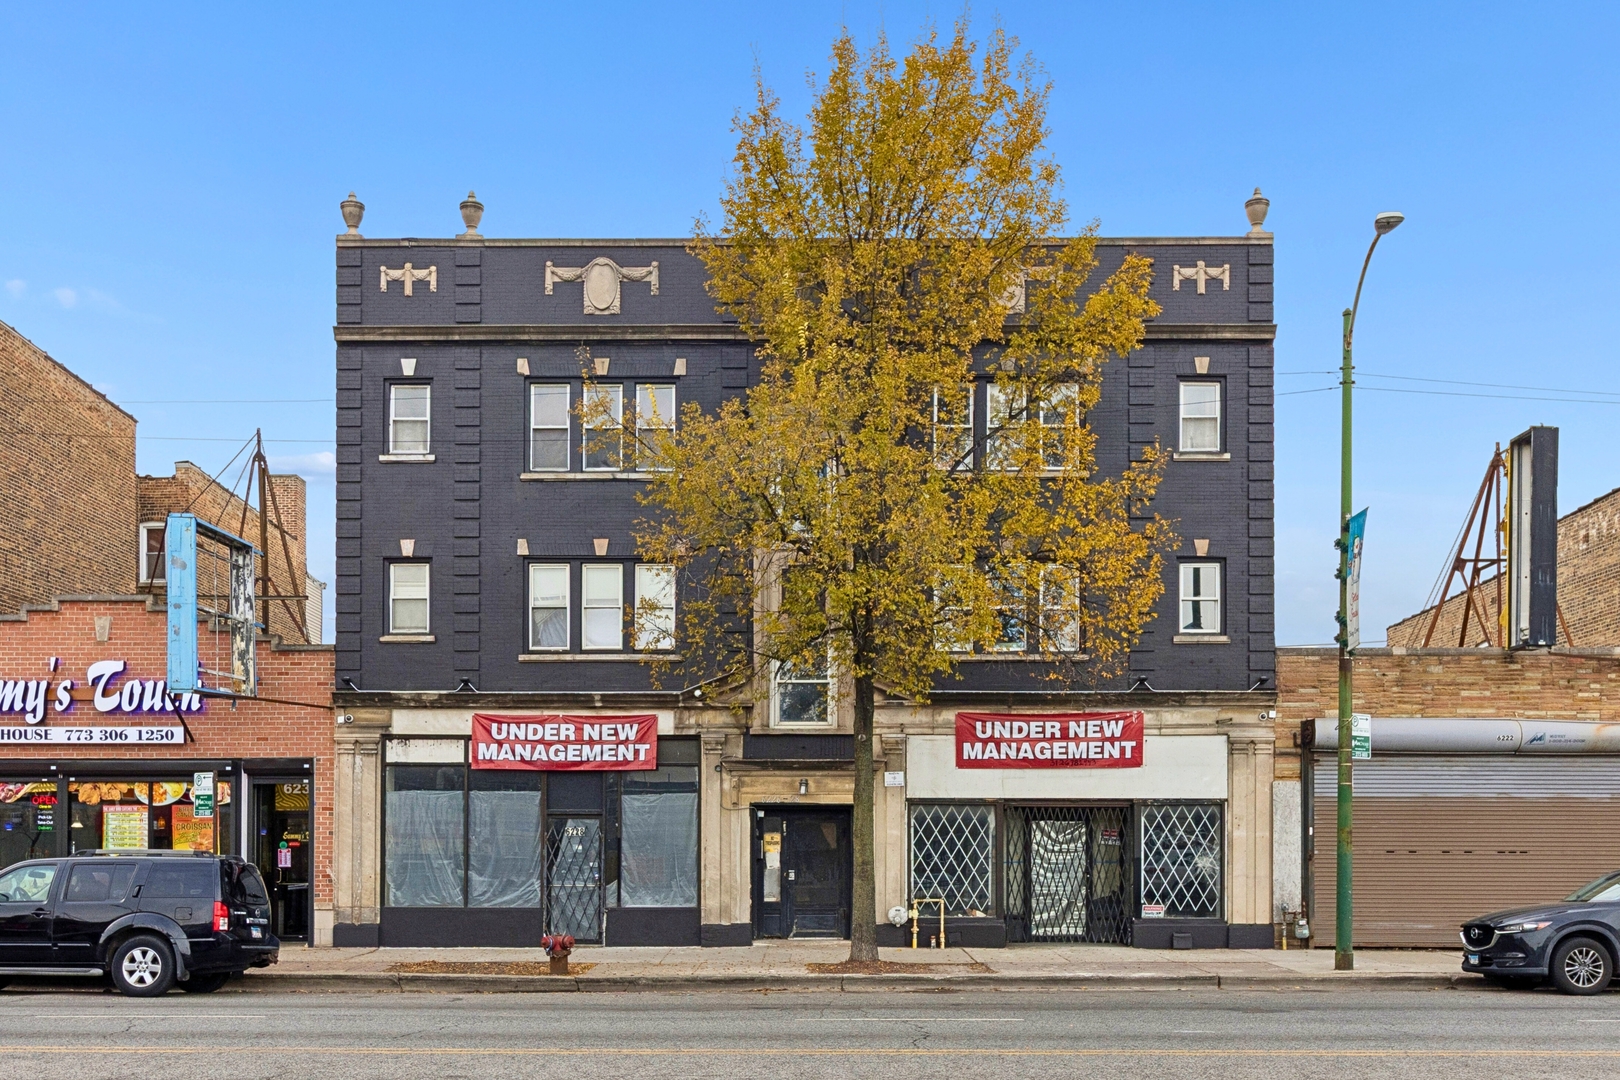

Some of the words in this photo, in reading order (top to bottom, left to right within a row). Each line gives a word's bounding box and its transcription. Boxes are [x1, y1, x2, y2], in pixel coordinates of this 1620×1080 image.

[490, 723, 576, 741] UNDER
[582, 723, 639, 741] NEW
[975, 721, 1061, 739] UNDER
[1067, 719, 1125, 739] NEW
[1, 729, 53, 741] HOUSE
[65, 729, 94, 741] 773
[100, 729, 128, 741] 306
[136, 729, 175, 741] 1250
[1496, 734, 1514, 742] 6222
[477, 742, 651, 762] MANAGEMENT
[962, 740, 1137, 761] MANAGEMENT
[283, 784, 309, 794] 623
[32, 796, 58, 805] OPEN
[176, 822, 213, 832] CROISSAN
[565, 827, 585, 835] 6228
